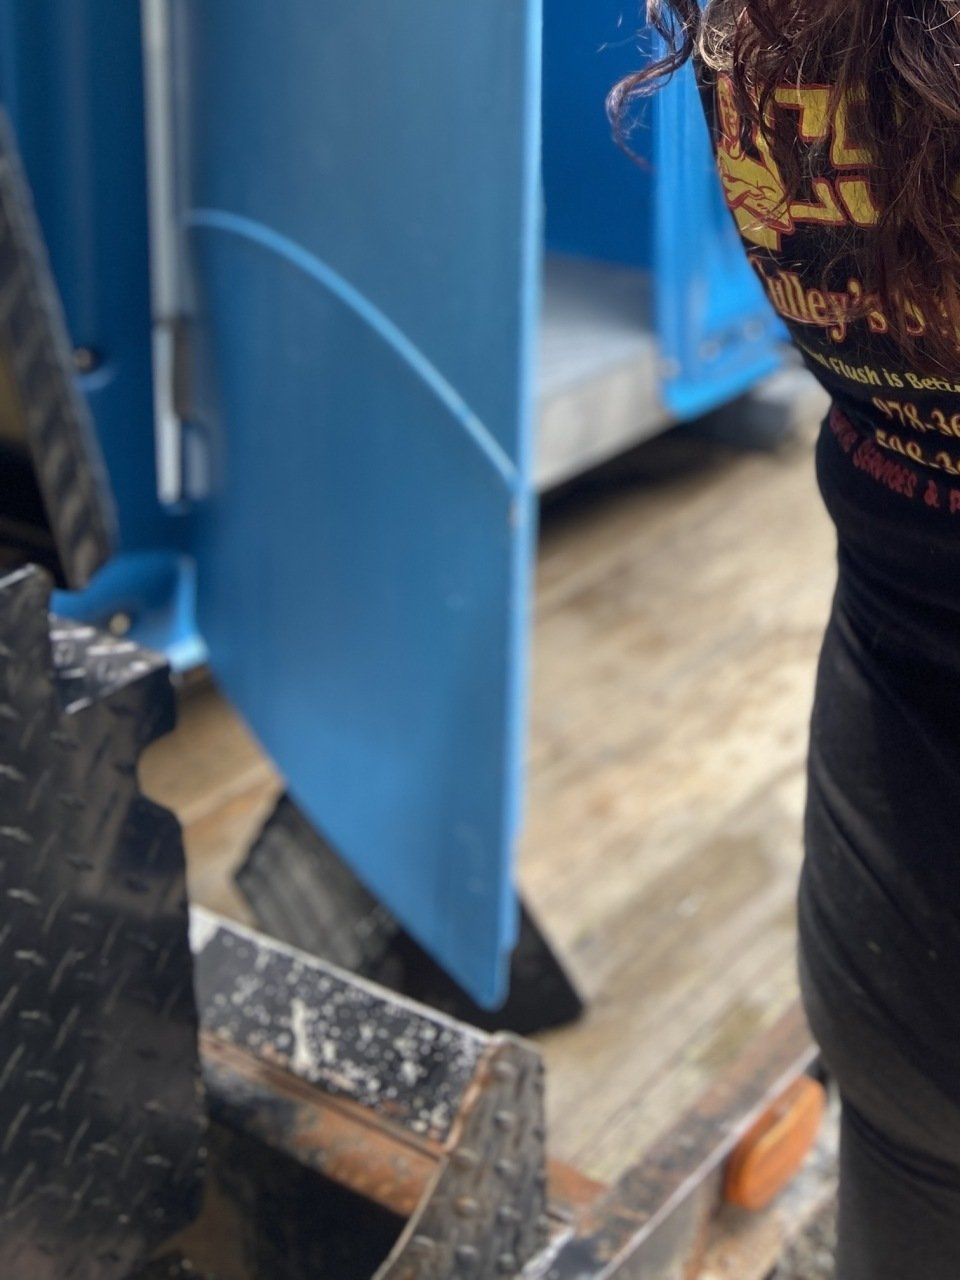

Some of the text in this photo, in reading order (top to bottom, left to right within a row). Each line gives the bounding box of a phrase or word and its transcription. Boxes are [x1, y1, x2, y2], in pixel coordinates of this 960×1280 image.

[750, 255, 890, 344] ulley's
[829, 355, 882, 387] Flush
[884, 367, 904, 389] is
